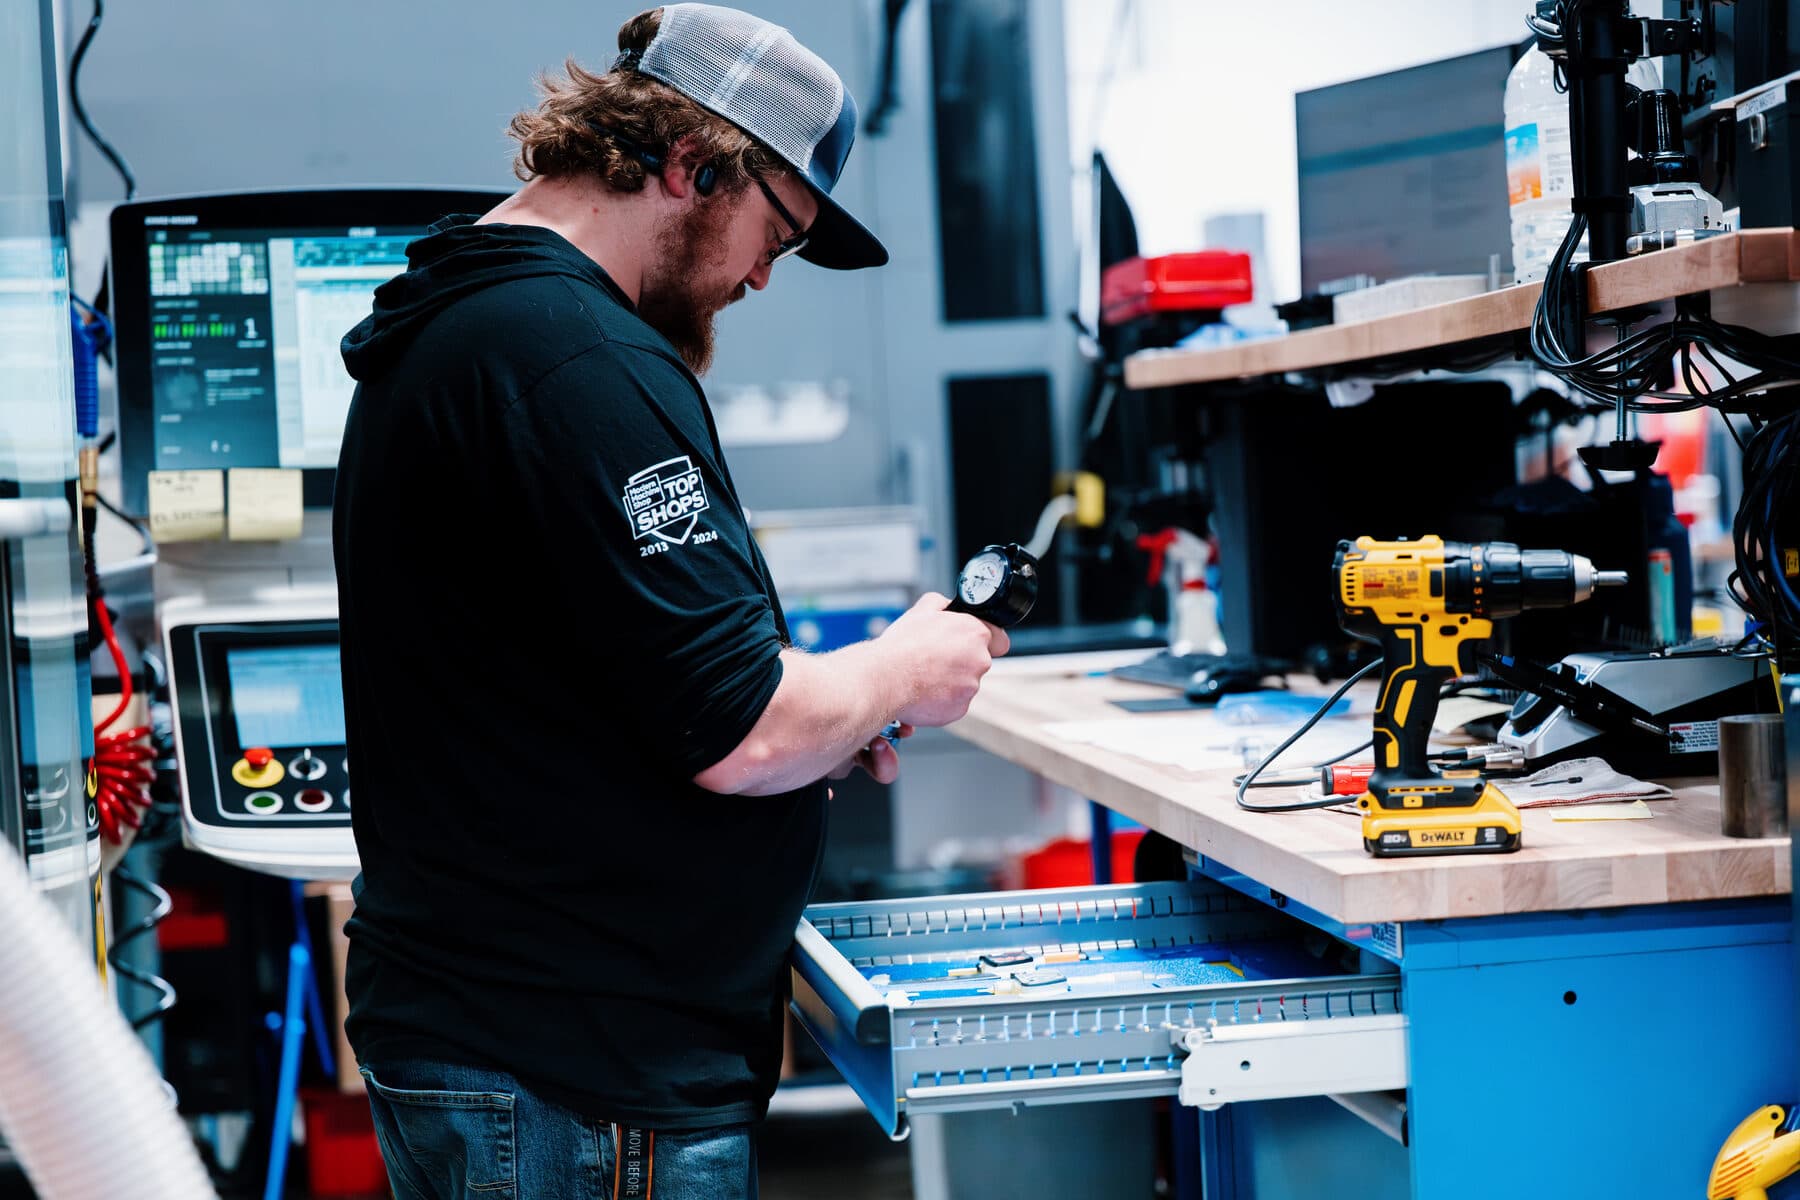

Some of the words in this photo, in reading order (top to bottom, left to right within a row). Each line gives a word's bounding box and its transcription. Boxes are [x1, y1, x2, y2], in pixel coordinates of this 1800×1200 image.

[245, 318, 258, 338] 1
[629, 481, 657, 494] Modern
[663, 473, 699, 498] TOP
[631, 487, 660, 503] Machine
[633, 497, 652, 510] Shop
[637, 491, 705, 531] SHOPS
[692, 530, 718, 545] 2024
[640, 541, 669, 557] 2013
[626, 1161, 640, 1196] BEFORE
